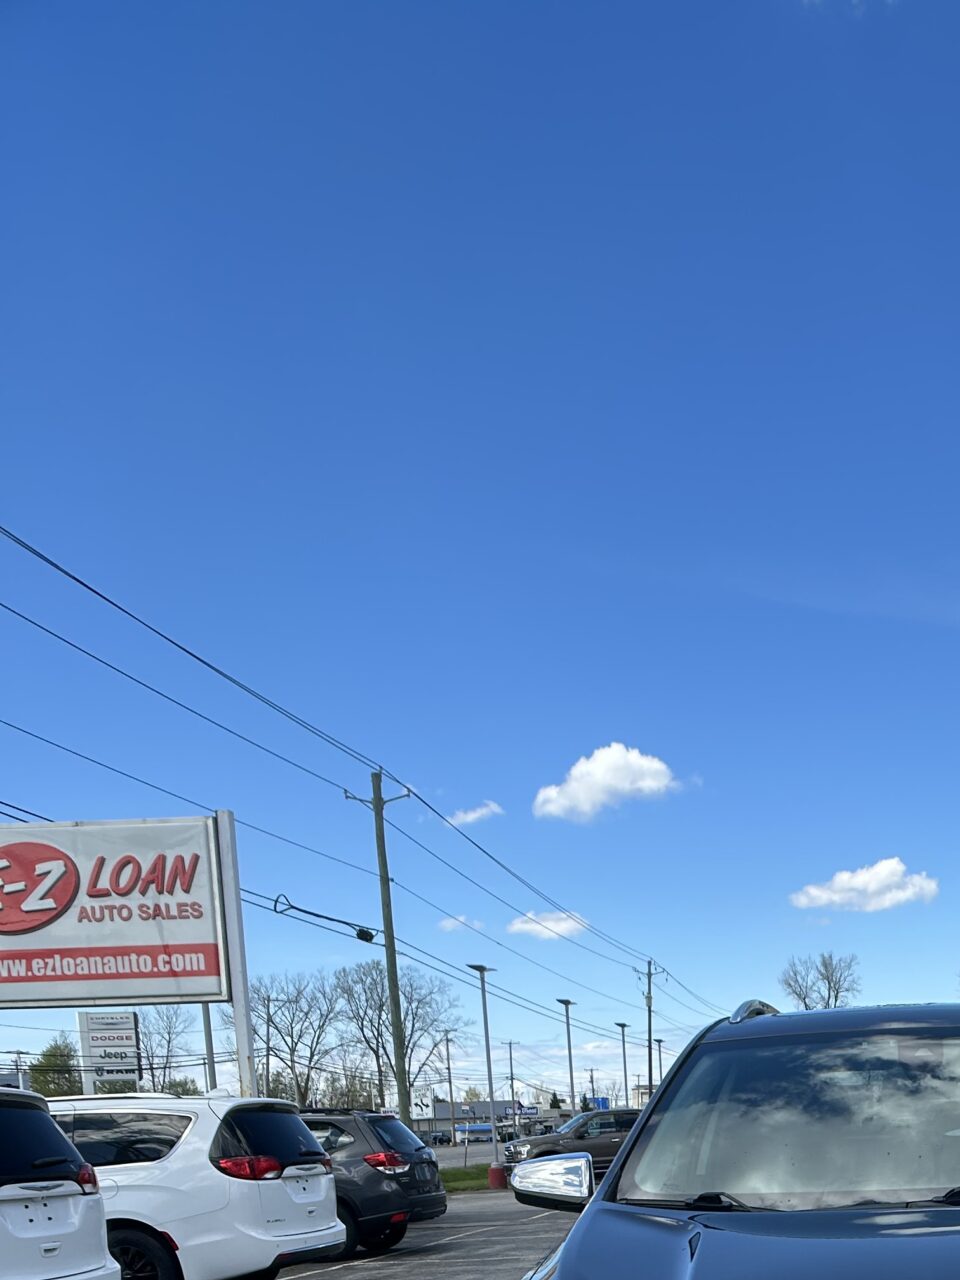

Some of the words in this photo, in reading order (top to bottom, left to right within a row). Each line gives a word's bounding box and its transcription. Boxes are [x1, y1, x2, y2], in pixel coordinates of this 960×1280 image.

[0, 859, 66, 911] -Z
[86, 852, 200, 898] LOAN
[78, 905, 133, 923] AUTO
[138, 902, 203, 920] SALES
[99, 1049, 128, 1061] Jeep
